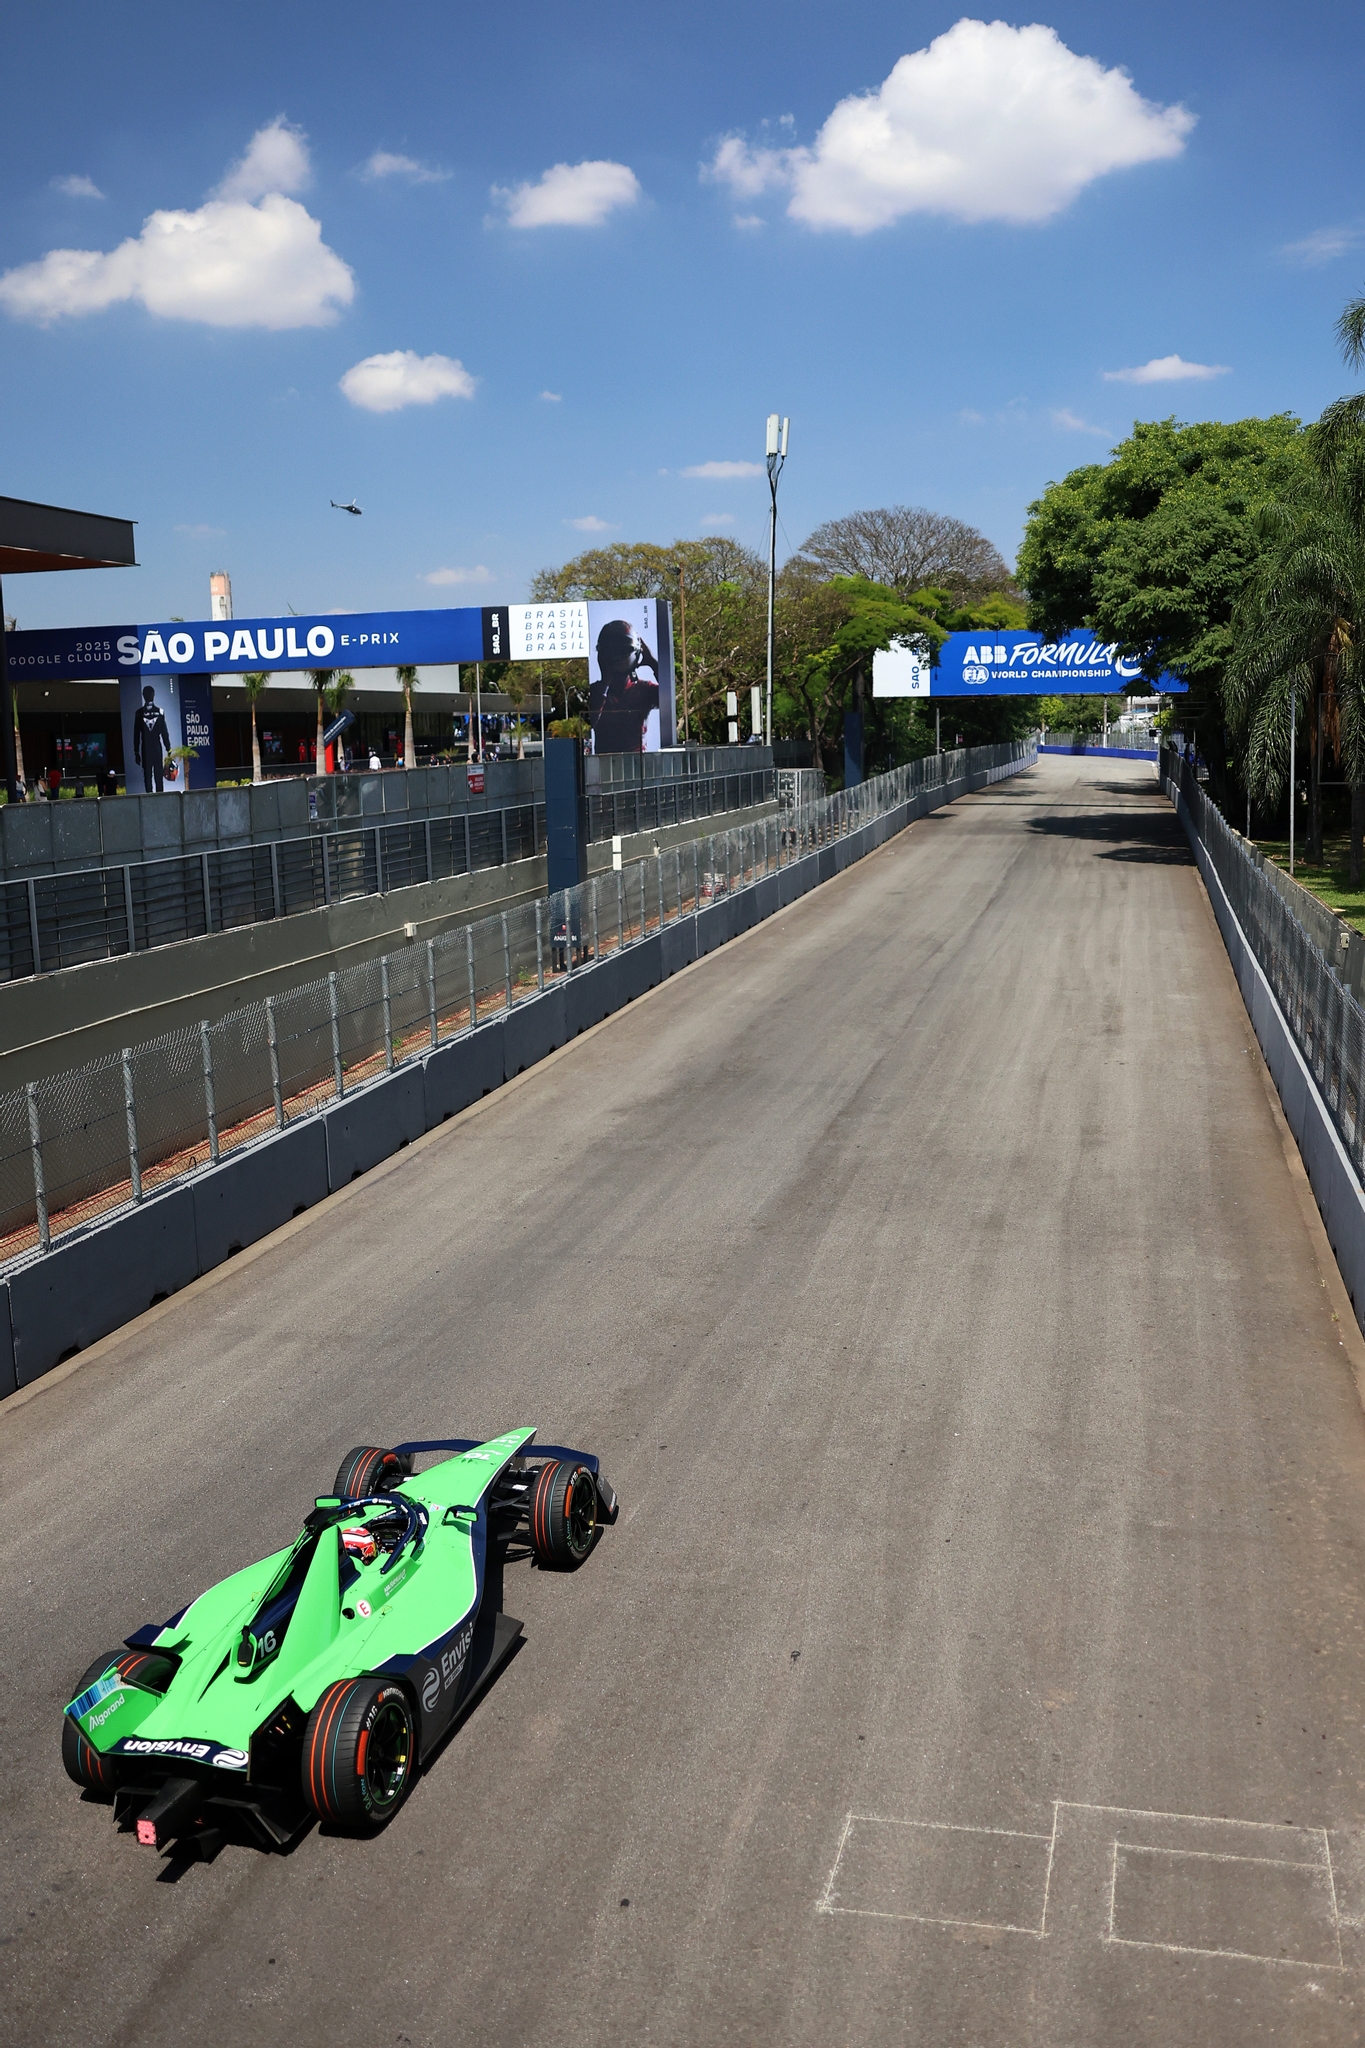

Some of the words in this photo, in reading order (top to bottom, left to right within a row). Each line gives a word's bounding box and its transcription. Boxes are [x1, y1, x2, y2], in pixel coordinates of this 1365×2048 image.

[524, 609, 583, 619] BRASIL
[525, 620, 584, 630] BRASIL
[491, 613, 501, 655] SAO_BR
[525, 631, 584, 641] BRASIL
[75, 641, 111, 651] 2025
[116, 629, 195, 665] SÃO
[204, 625, 335, 662] PAULO
[341, 632, 399, 646] E-PRIX
[525, 641, 585, 652] BRASIL
[9, 654, 61, 666] GOOGLE
[67, 652, 112, 663] CLOUD
[962, 645, 1008, 665] ABB
[1008, 641, 1119, 667] FORMULA
[963, 667, 988, 682] FIA
[991, 670, 1028, 679] WORLD
[1031, 669, 1112, 678] CHAMPIONSHIP
[185, 710, 200, 724] SÃO
[186, 725, 209, 735] PAULO
[187, 736, 210, 747] E-PRIX
[258, 1630, 277, 1659] 16
[89, 1693, 126, 1732] Algorand
[123, 1739, 211, 1758] Envision
